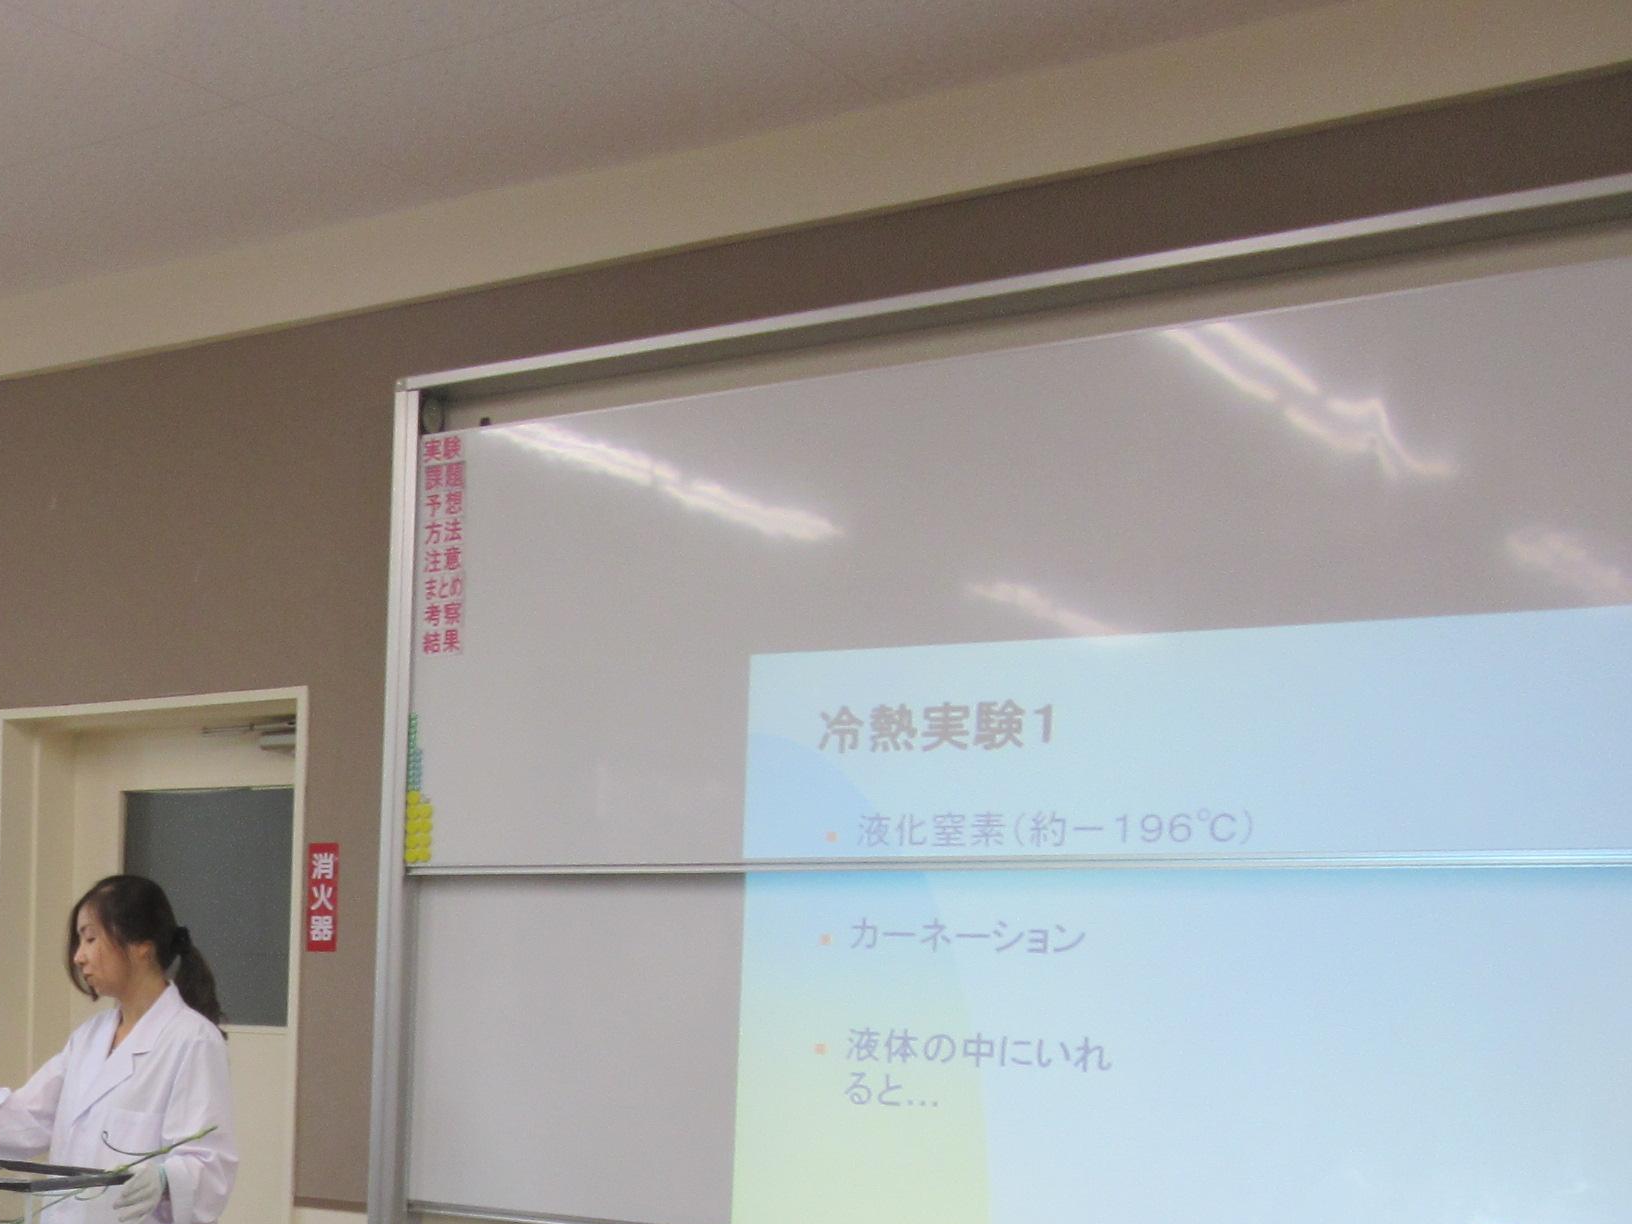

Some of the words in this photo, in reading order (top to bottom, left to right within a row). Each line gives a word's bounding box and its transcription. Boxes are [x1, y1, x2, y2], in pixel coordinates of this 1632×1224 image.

[423, 436, 461, 462] 実験
[424, 463, 465, 491] 課題
[425, 492, 463, 517] 予想
[425, 519, 463, 544] 方法
[424, 546, 461, 573] 注意
[425, 577, 463, 600] まとめ
[424, 603, 462, 626] 考察
[423, 630, 460, 654] 結果
[817, 699, 1055, 754] 冷熱実験1
[310, 852, 335, 941] 消火器
[849, 916, 1086, 954] カーネーション
[844, 1027, 1113, 1074] 液体の中にいれ
